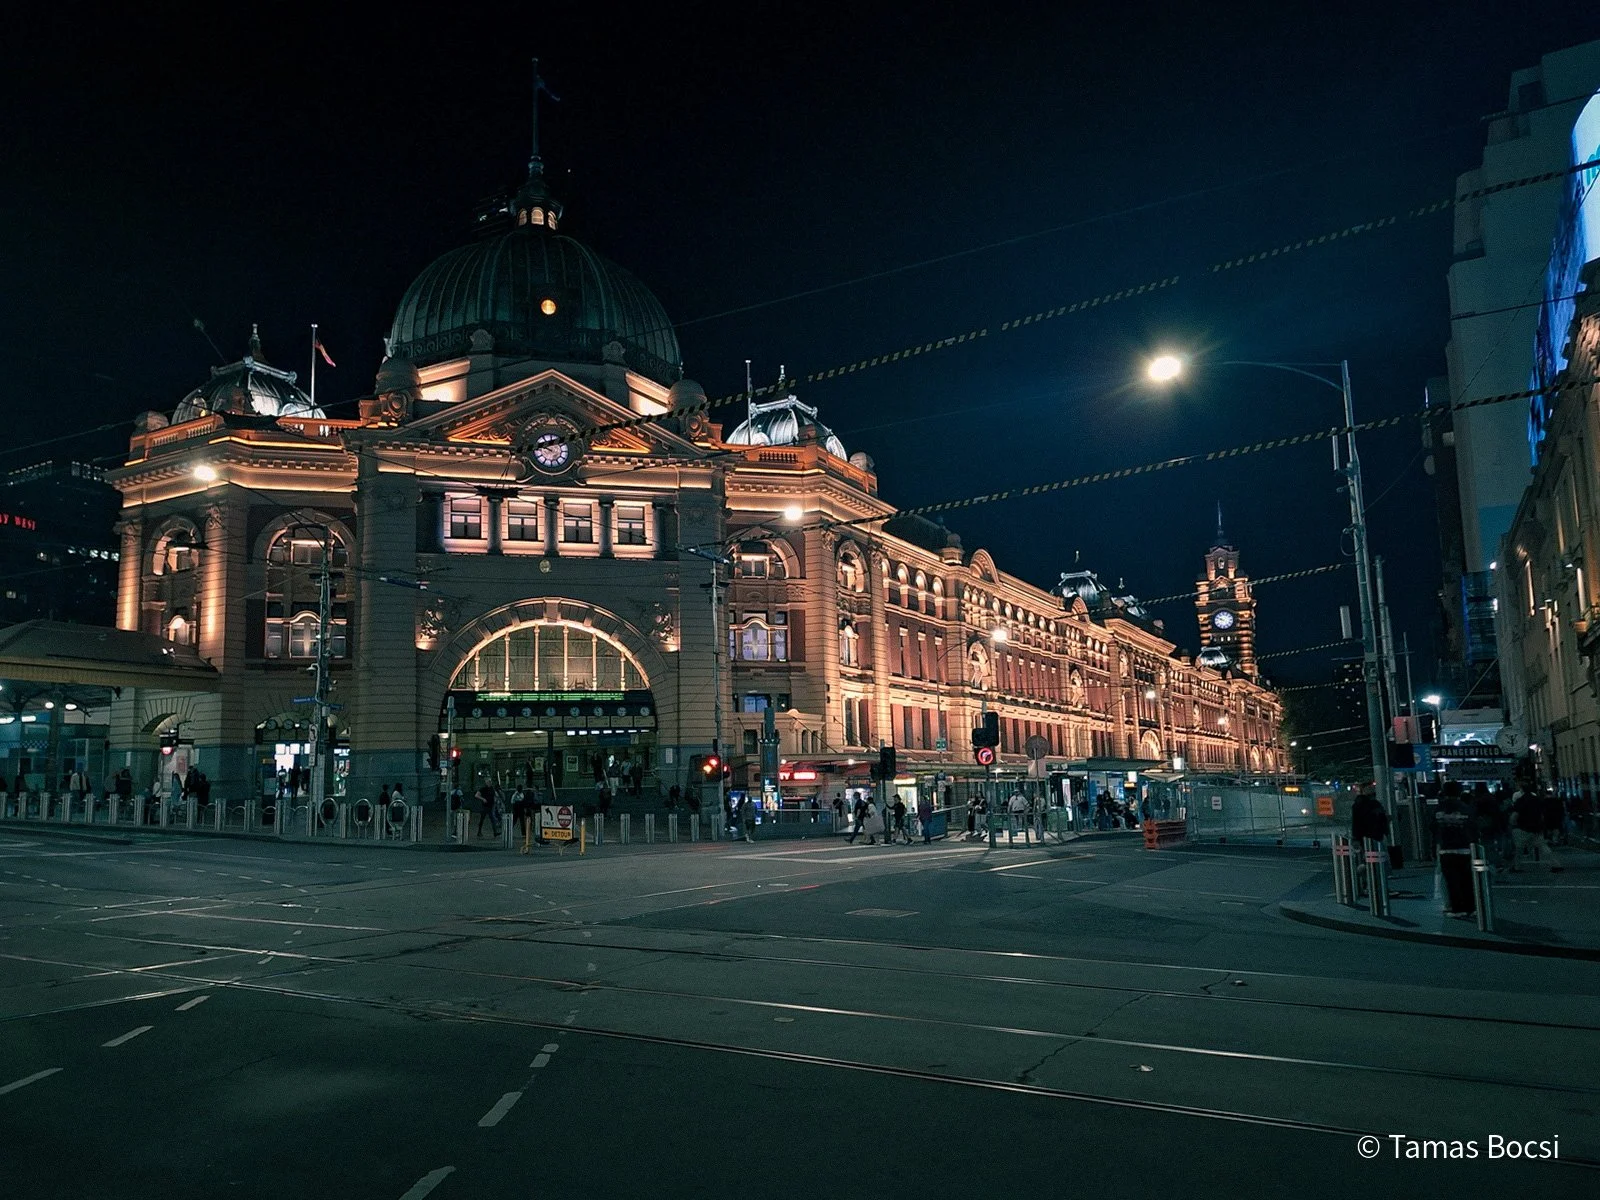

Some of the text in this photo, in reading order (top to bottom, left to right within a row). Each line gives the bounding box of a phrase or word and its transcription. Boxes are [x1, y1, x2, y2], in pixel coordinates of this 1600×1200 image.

[14, 515, 36, 531] WEST
[1441, 747, 1500, 756] DANGERFIELD
[551, 830, 571, 838] DETOUR
